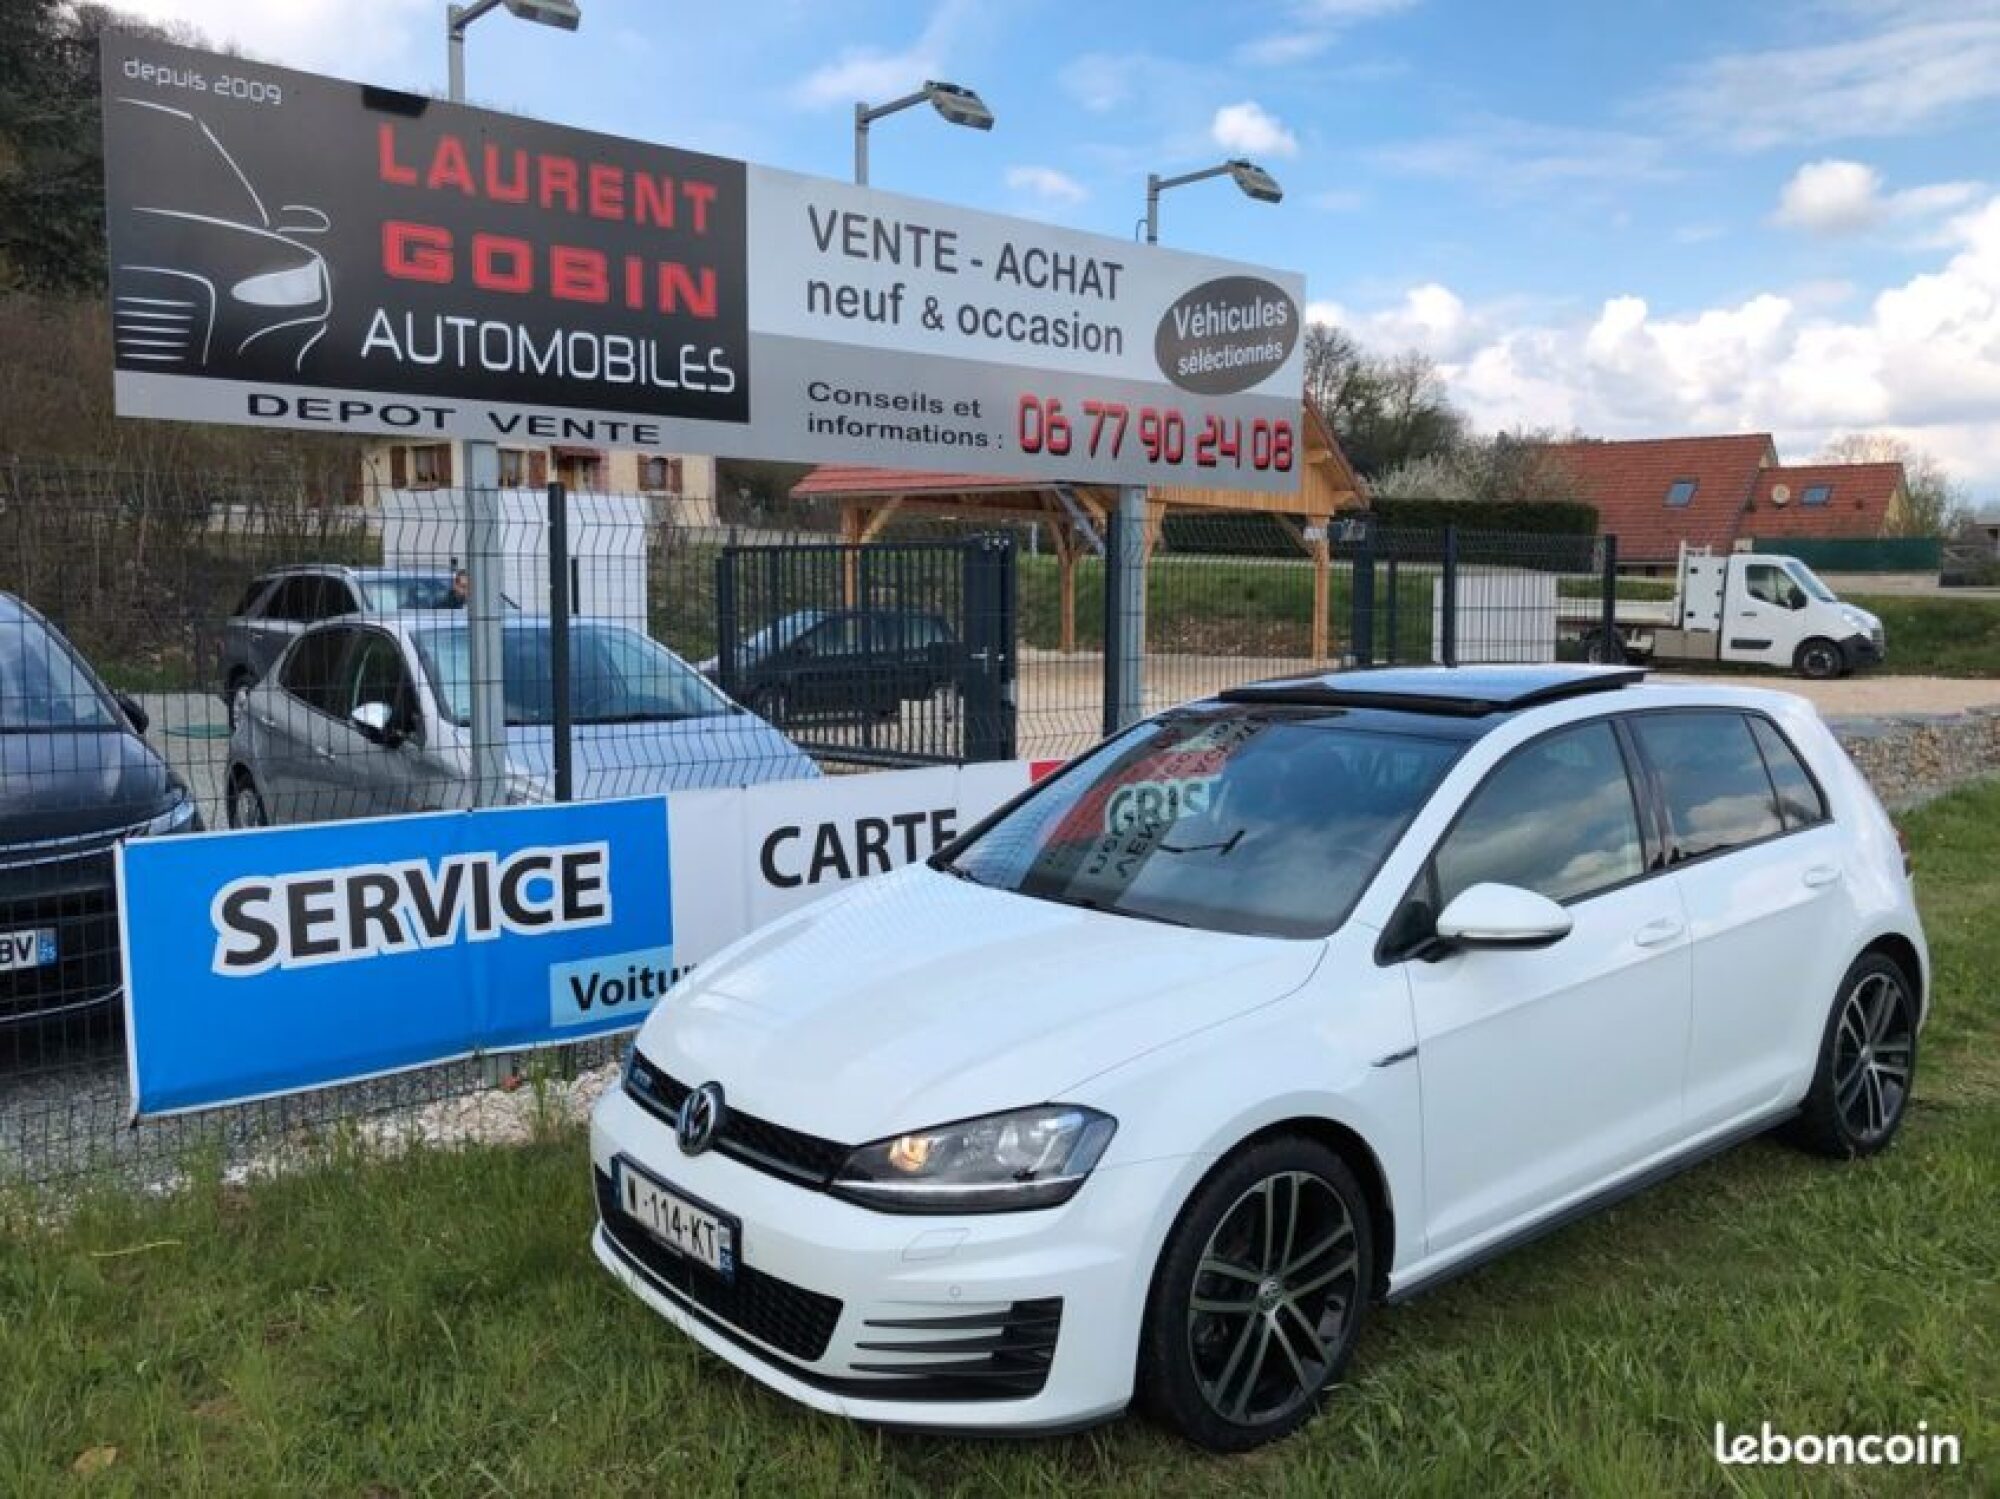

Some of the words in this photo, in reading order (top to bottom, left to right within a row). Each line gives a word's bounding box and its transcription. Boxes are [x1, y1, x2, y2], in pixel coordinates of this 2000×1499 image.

[124, 56, 206, 91] depuis
[214, 75, 283, 105] 2009
[377, 122, 717, 234] LAURENT
[382, 220, 718, 319] GOBIN
[808, 205, 958, 274] VENTE
[996, 243, 1124, 300] ACHAT
[361, 309, 736, 394] AUTOMOBILES
[807, 280, 905, 325] neuf
[921, 297, 945, 331] &
[958, 303, 1124, 355] occasion
[1173, 295, 1288, 341] Véhicules
[247, 394, 456, 431] DEPOT
[488, 412, 661, 445] VENTE
[808, 382, 944, 415] Conseils
[953, 398, 981, 419] et
[808, 413, 989, 449] informations
[1017, 394, 1072, 457] 06
[1082, 400, 1129, 460] 77
[1139, 409, 1184, 464] 90
[1195, 417, 1242, 469] 24
[1253, 419, 1294, 473] 08
[760, 807, 957, 888] CARTE
[219, 849, 606, 967] SERVICE
[568, 963, 698, 1011] Voitu
